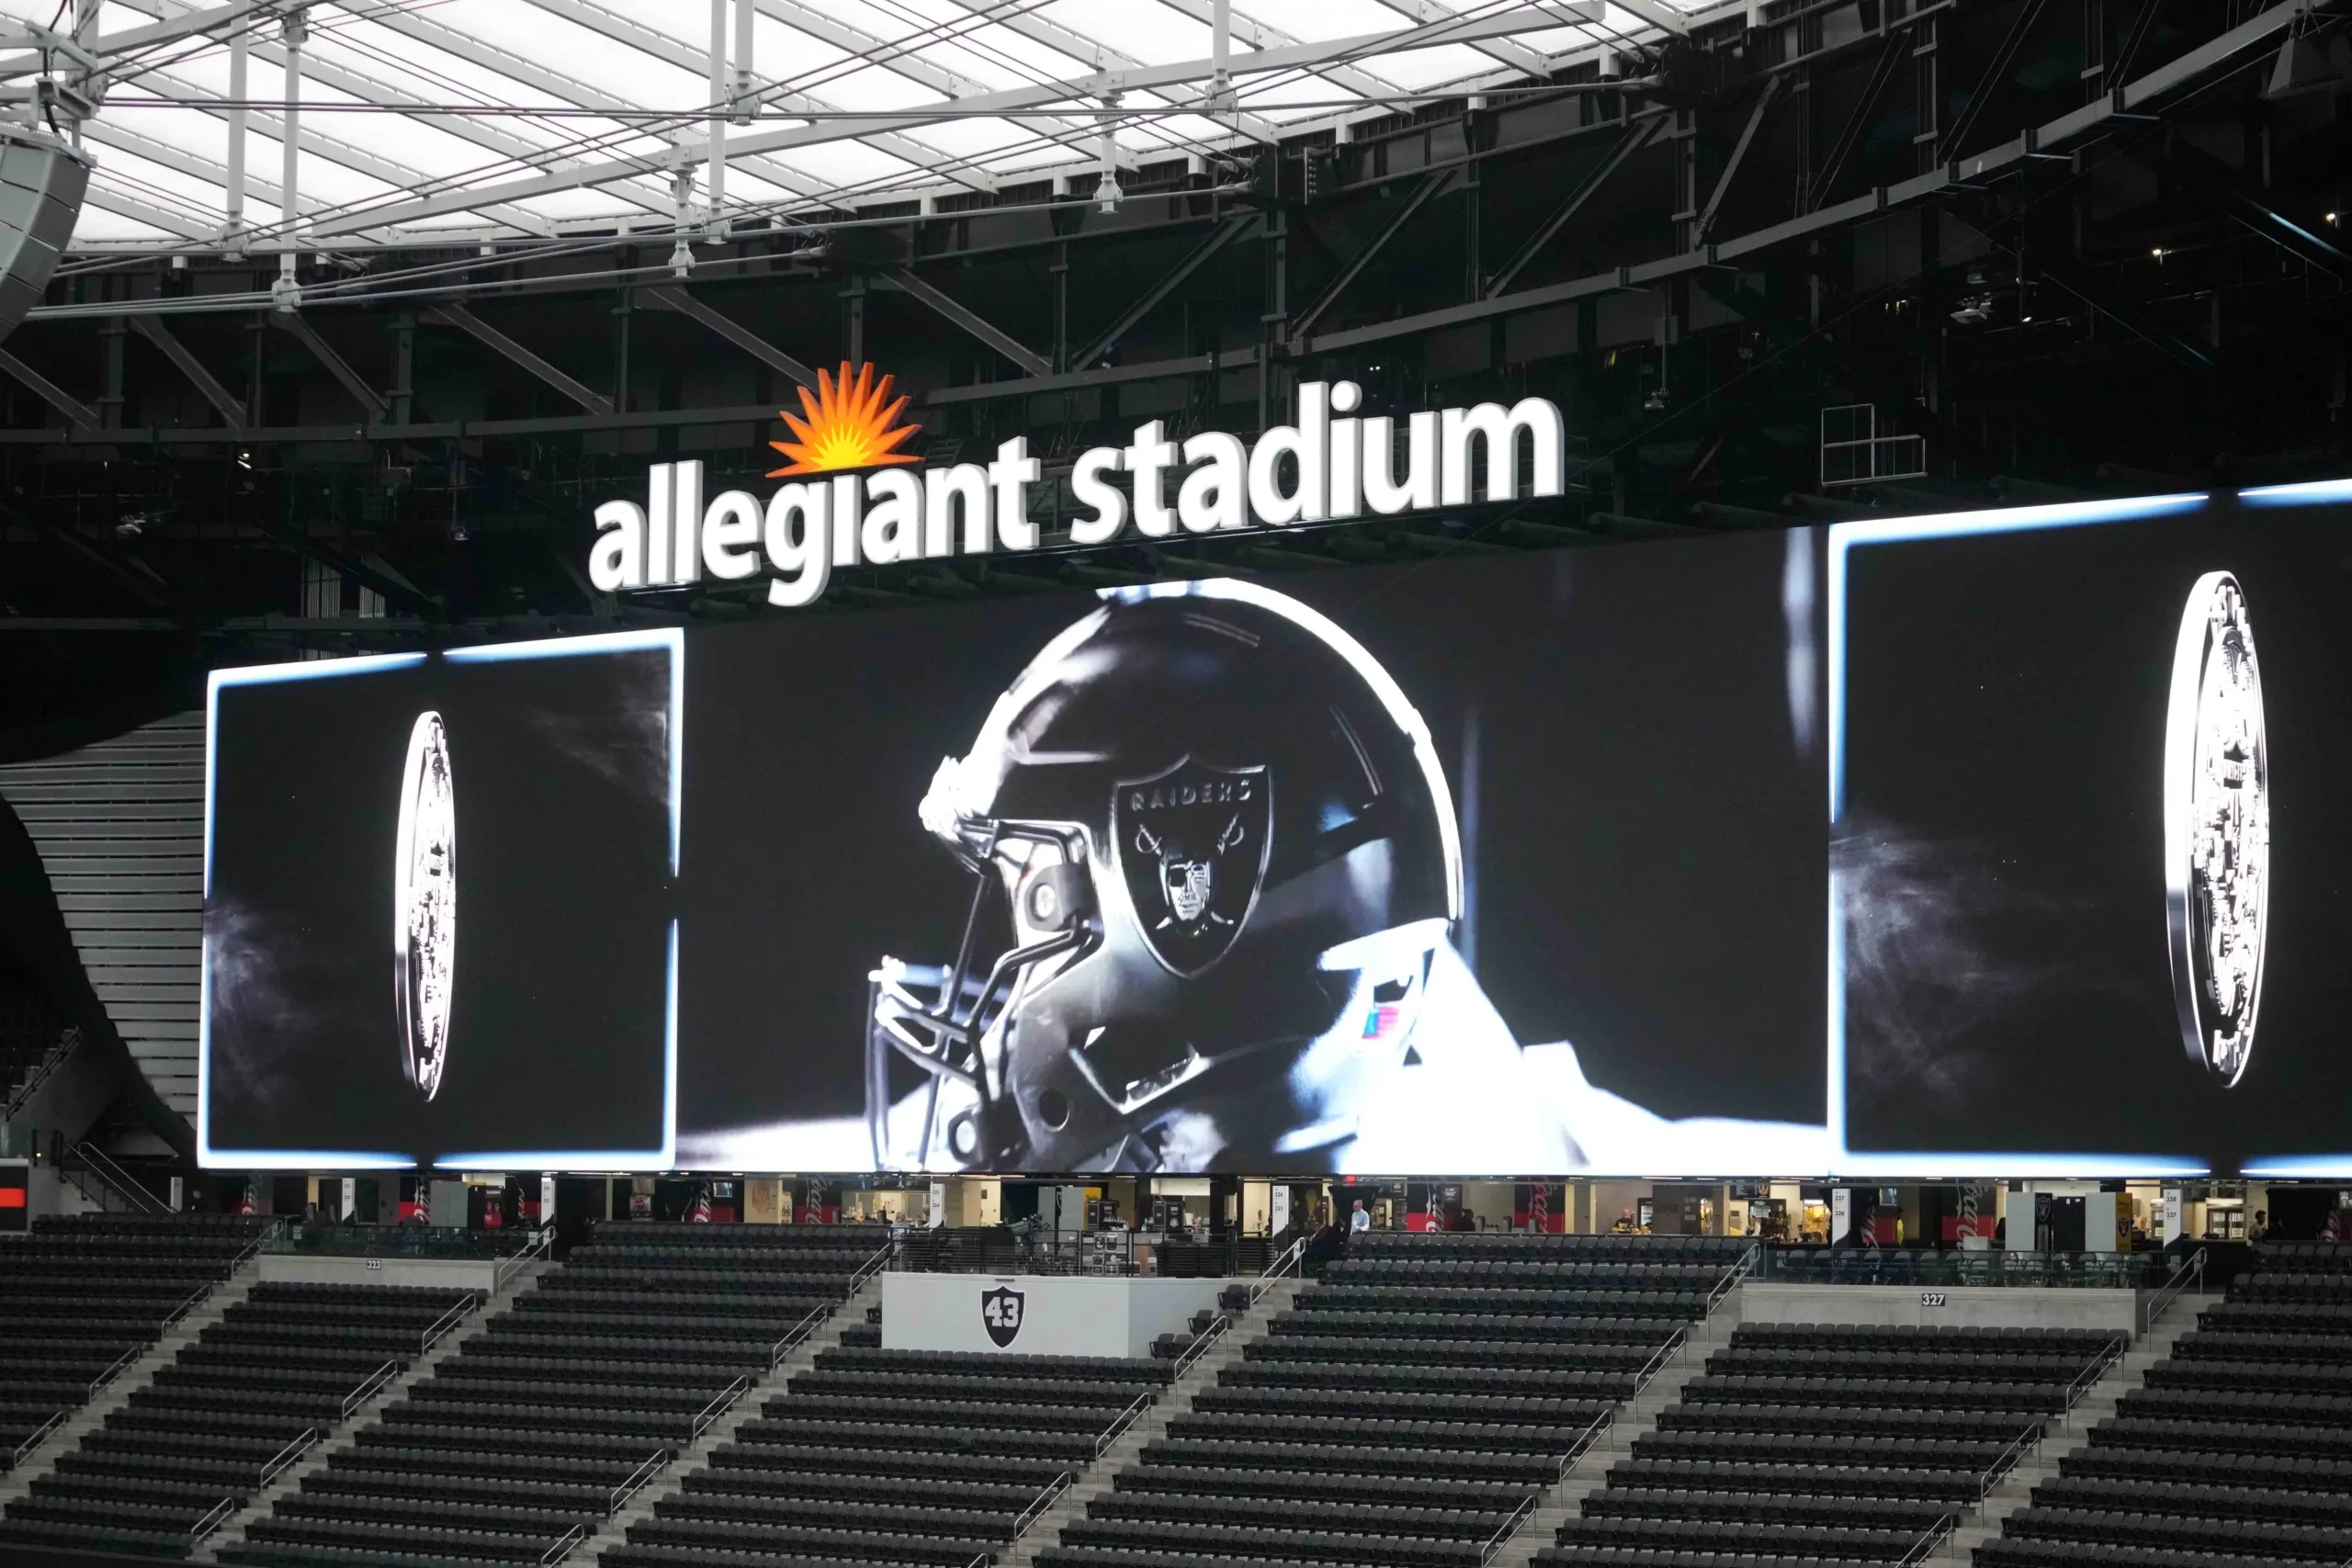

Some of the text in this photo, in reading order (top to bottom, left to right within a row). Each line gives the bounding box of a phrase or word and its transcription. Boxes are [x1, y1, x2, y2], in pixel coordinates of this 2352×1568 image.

[588, 380, 1566, 606] allegiant stadium
[1130, 779, 1251, 812] RAIDERS
[367, 1259, 381, 1269] 323
[985, 1296, 1019, 1327] 43
[1922, 1293, 1945, 1306] 327
